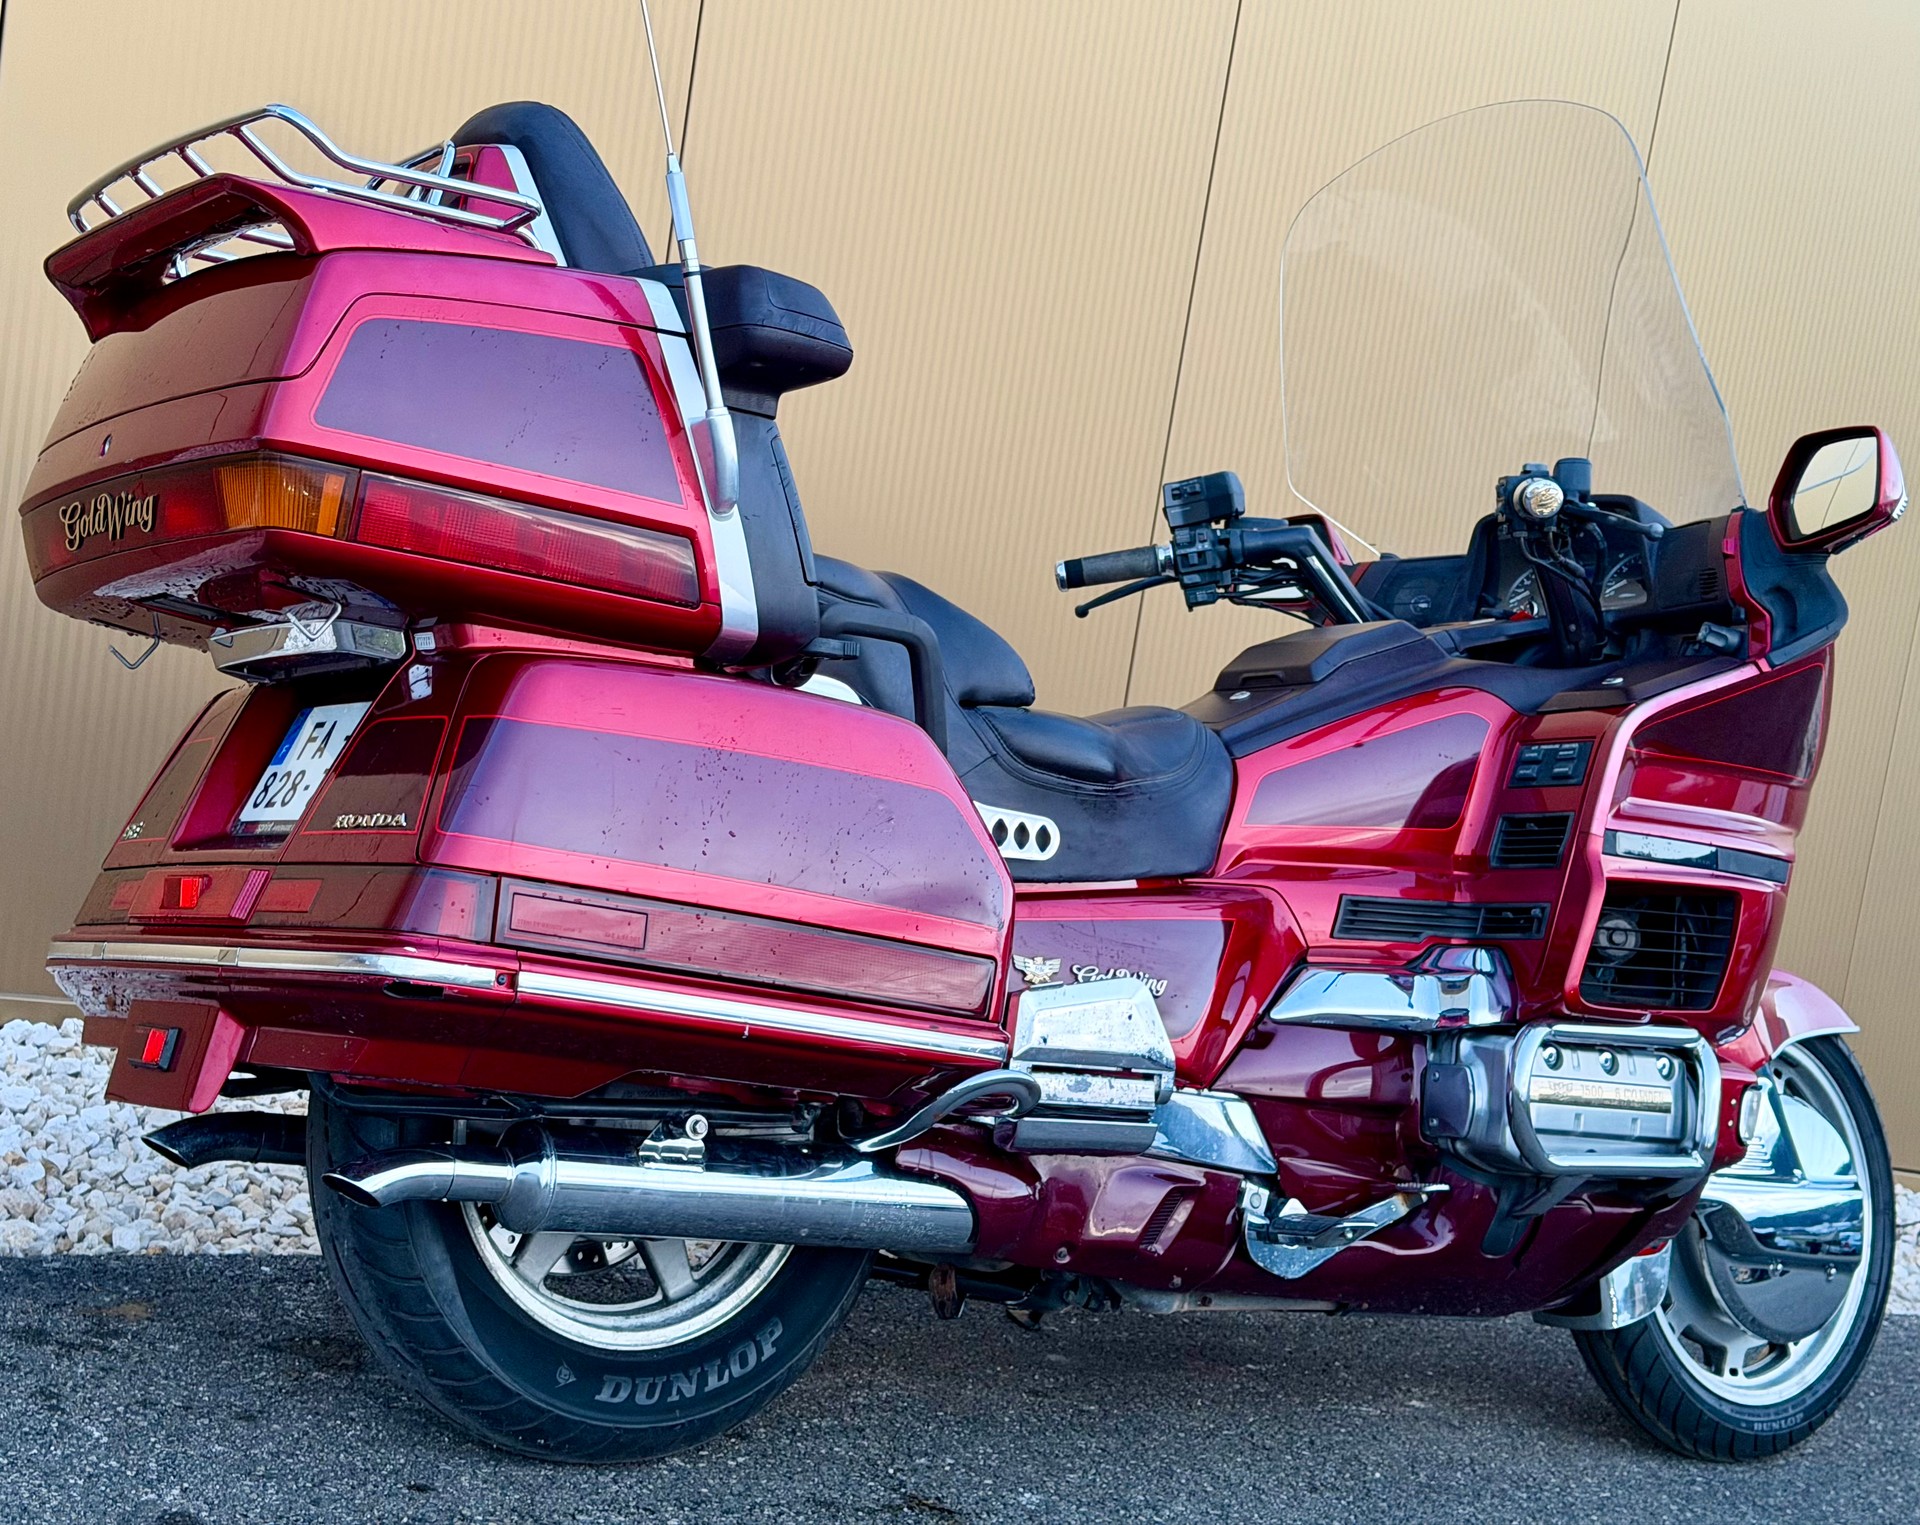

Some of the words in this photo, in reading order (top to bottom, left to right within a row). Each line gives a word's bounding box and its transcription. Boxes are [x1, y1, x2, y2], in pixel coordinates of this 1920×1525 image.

[59, 491, 156, 551] GoldWing
[333, 812, 407, 828] HONDA
[595, 1317, 783, 1405] DUNLOP
[1753, 1412, 1804, 1431] DUNLOP
